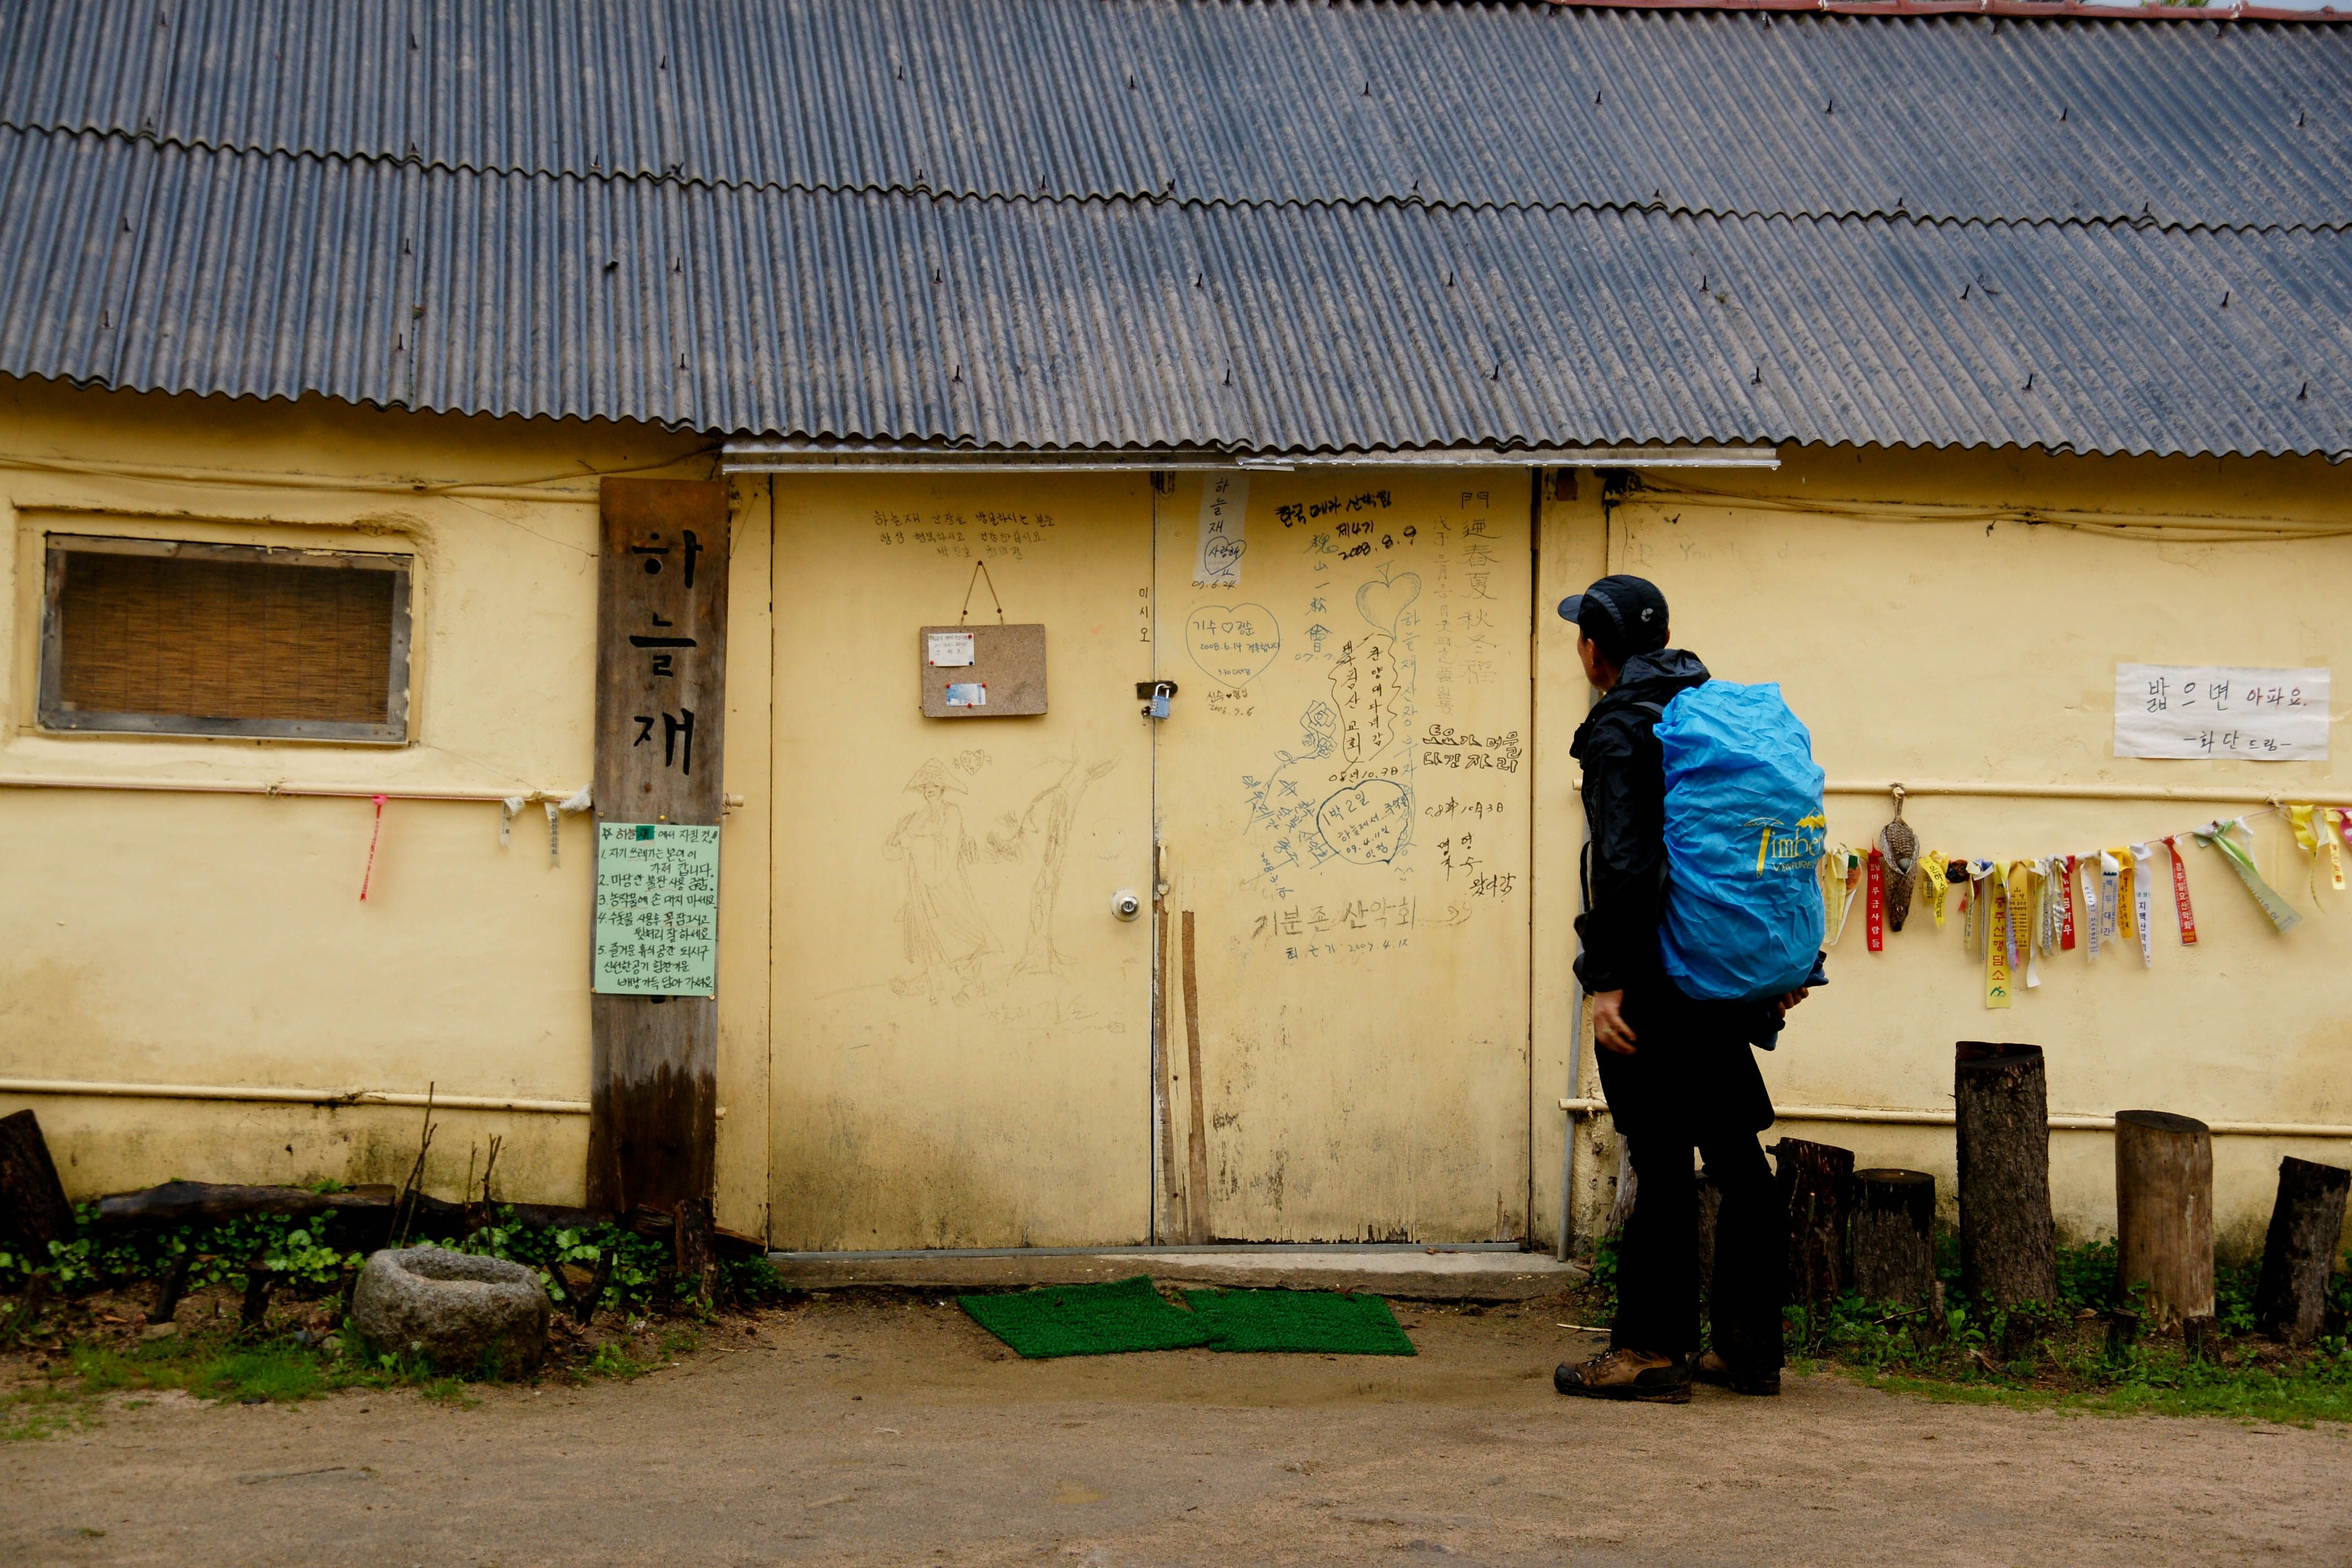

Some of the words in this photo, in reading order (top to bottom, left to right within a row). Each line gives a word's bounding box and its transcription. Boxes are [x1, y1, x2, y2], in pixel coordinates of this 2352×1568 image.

[873, 510, 921, 526] 하늘재
[1208, 545, 1240, 558] 사랑해
[1139, 587, 1151, 642] 미시오
[1194, 620, 1217, 635] 기수
[629, 530, 704, 776] 하늘재
[2147, 677, 2229, 713] 밟으면
[2246, 687, 2308, 707] 아파요.
[679, 829, 698, 843] 지킬
[609, 848, 627, 859] 자기
[629, 848, 664, 862] 쓰레기는
[651, 863, 671, 874] 가져
[669, 876, 685, 891] 사용
[609, 892, 648, 908] 농작물에
[652, 892, 661, 906] 손
[664, 894, 683, 907] 대지
[2104, 879, 2113, 936] 백두대간
[1342, 895, 1416, 929] 산악회
[1871, 873, 1880, 948] 마루금사람들
[667, 928, 678, 943] 잘
[1992, 897, 2006, 981] 충주산행담소
[609, 942, 636, 958] 즐거운
